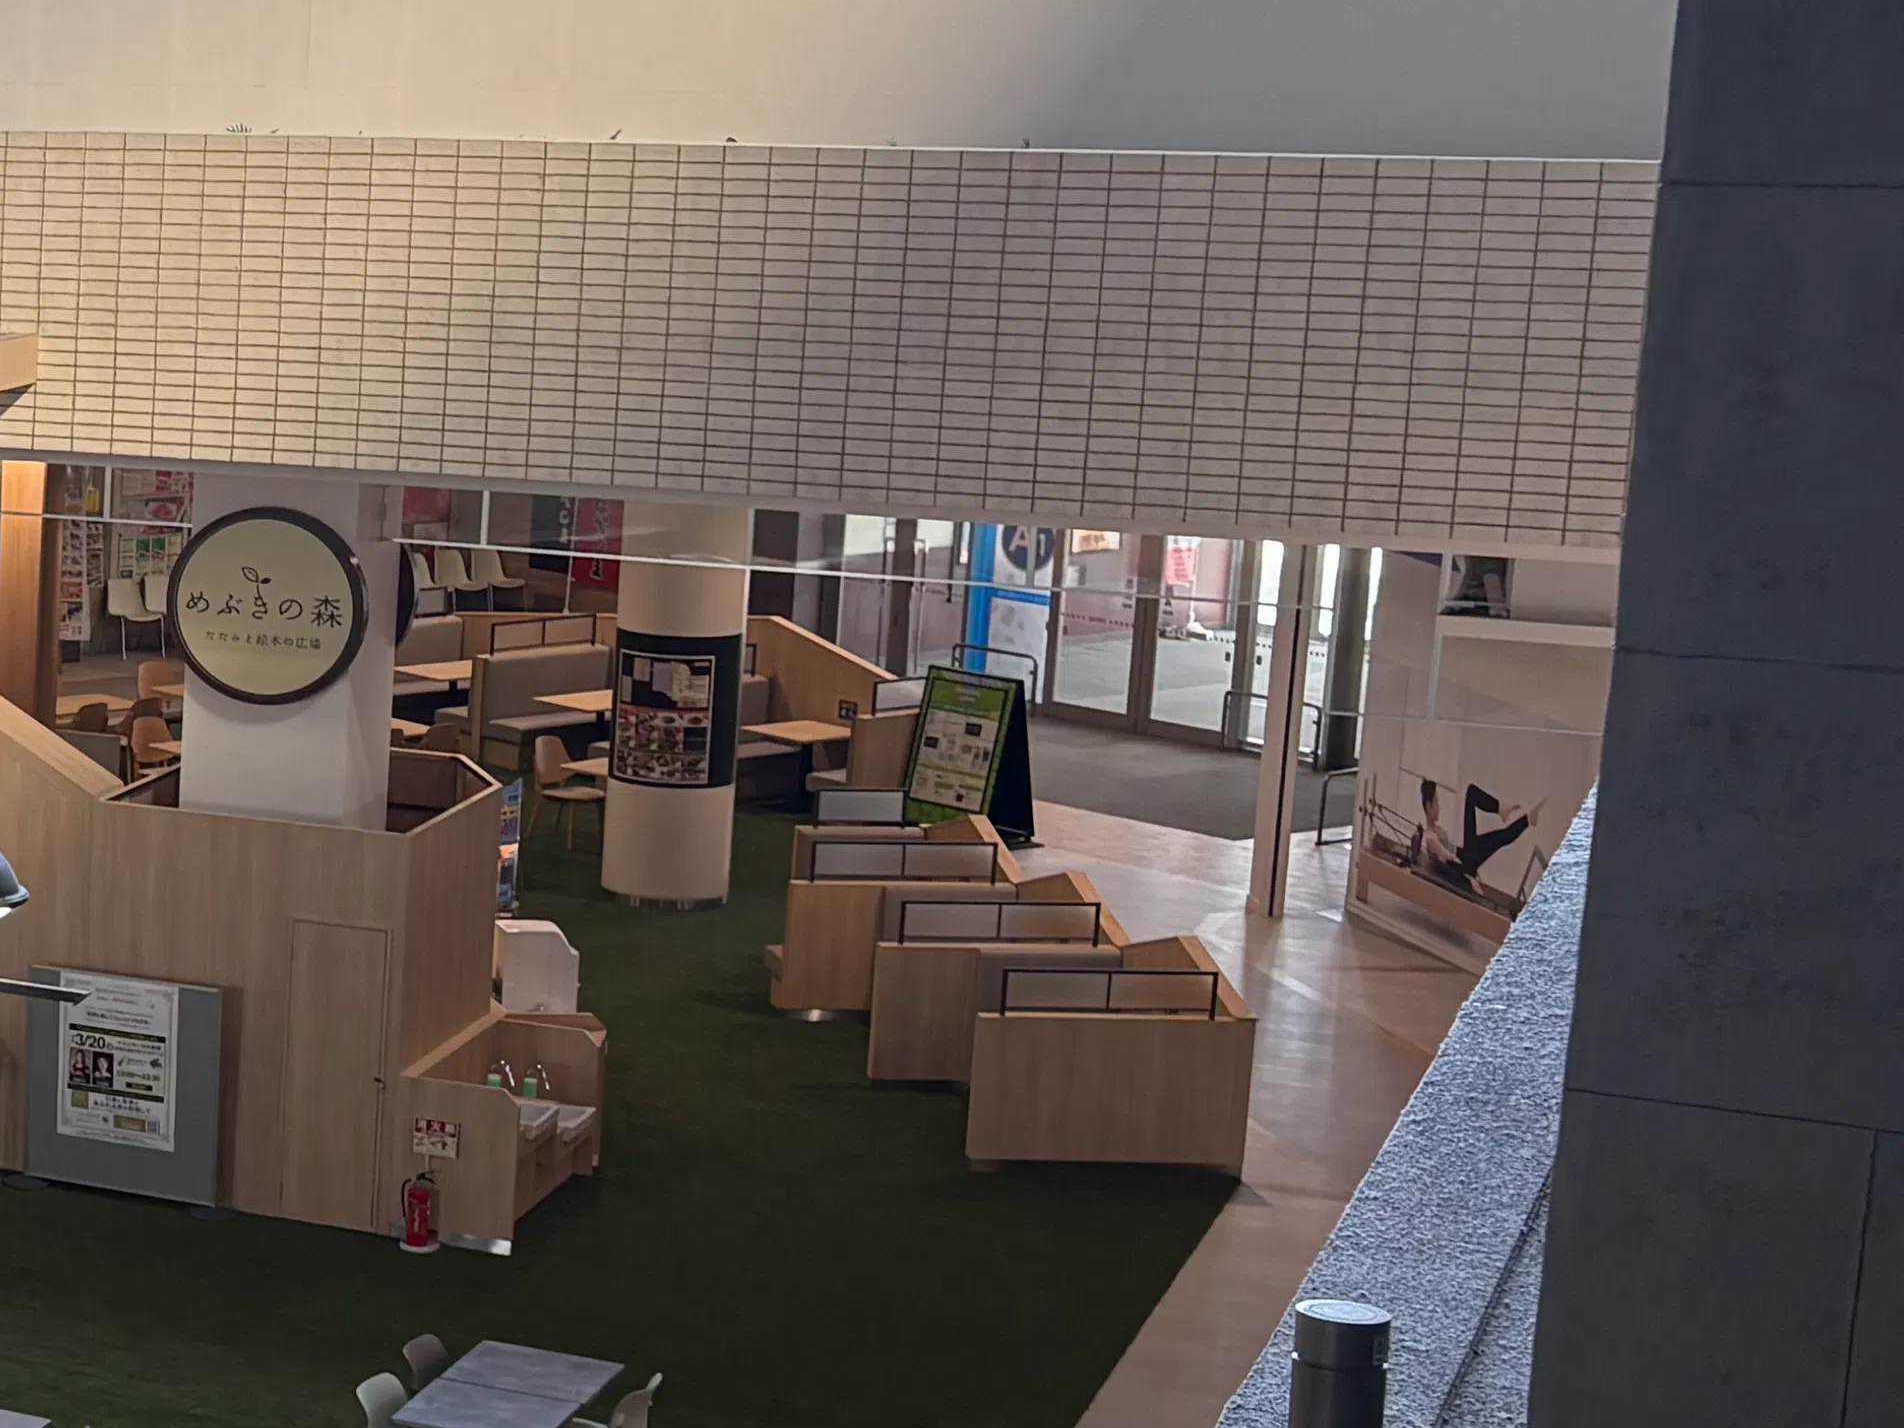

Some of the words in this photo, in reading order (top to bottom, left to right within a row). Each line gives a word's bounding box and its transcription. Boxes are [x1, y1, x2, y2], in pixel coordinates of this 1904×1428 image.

[186, 590, 343, 629] めぶきの森
[74, 1032, 106, 1050] 3/20
